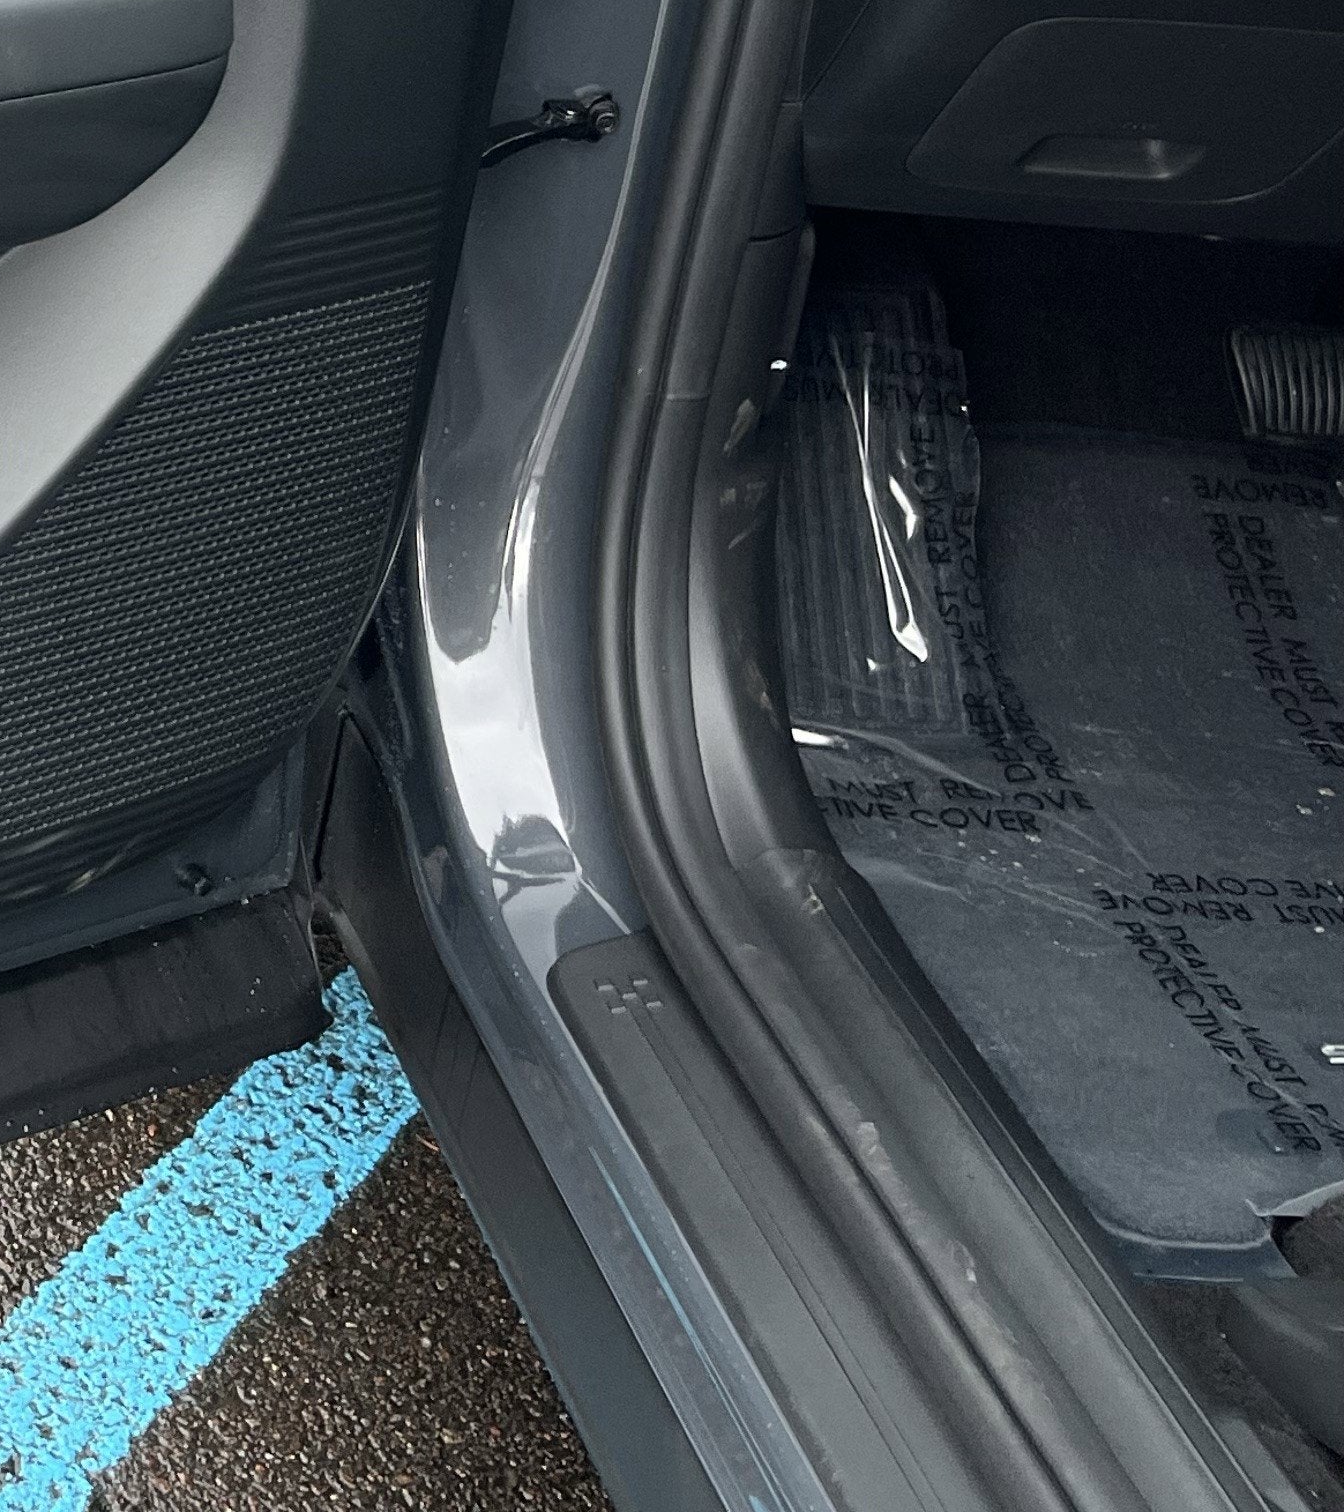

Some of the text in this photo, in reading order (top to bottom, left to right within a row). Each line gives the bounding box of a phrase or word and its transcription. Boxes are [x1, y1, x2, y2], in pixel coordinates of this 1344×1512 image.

[909, 427, 954, 568] REMOVE
[1192, 473, 1328, 509] REMOVE
[949, 490, 983, 609] COVER
[1203, 512, 1344, 768] PROTECTIVE COVER
[1238, 514, 1339, 708] DEALER MUST
[819, 796, 1041, 834] TIVE COVER
[826, 778, 918, 804] MUST
[1092, 889, 1255, 922] REMOVE
[1147, 872, 1278, 897] COVER
[1154, 920, 1243, 1012] DEALER
[1114, 920, 1322, 1152] PROTECTIVE COVER
